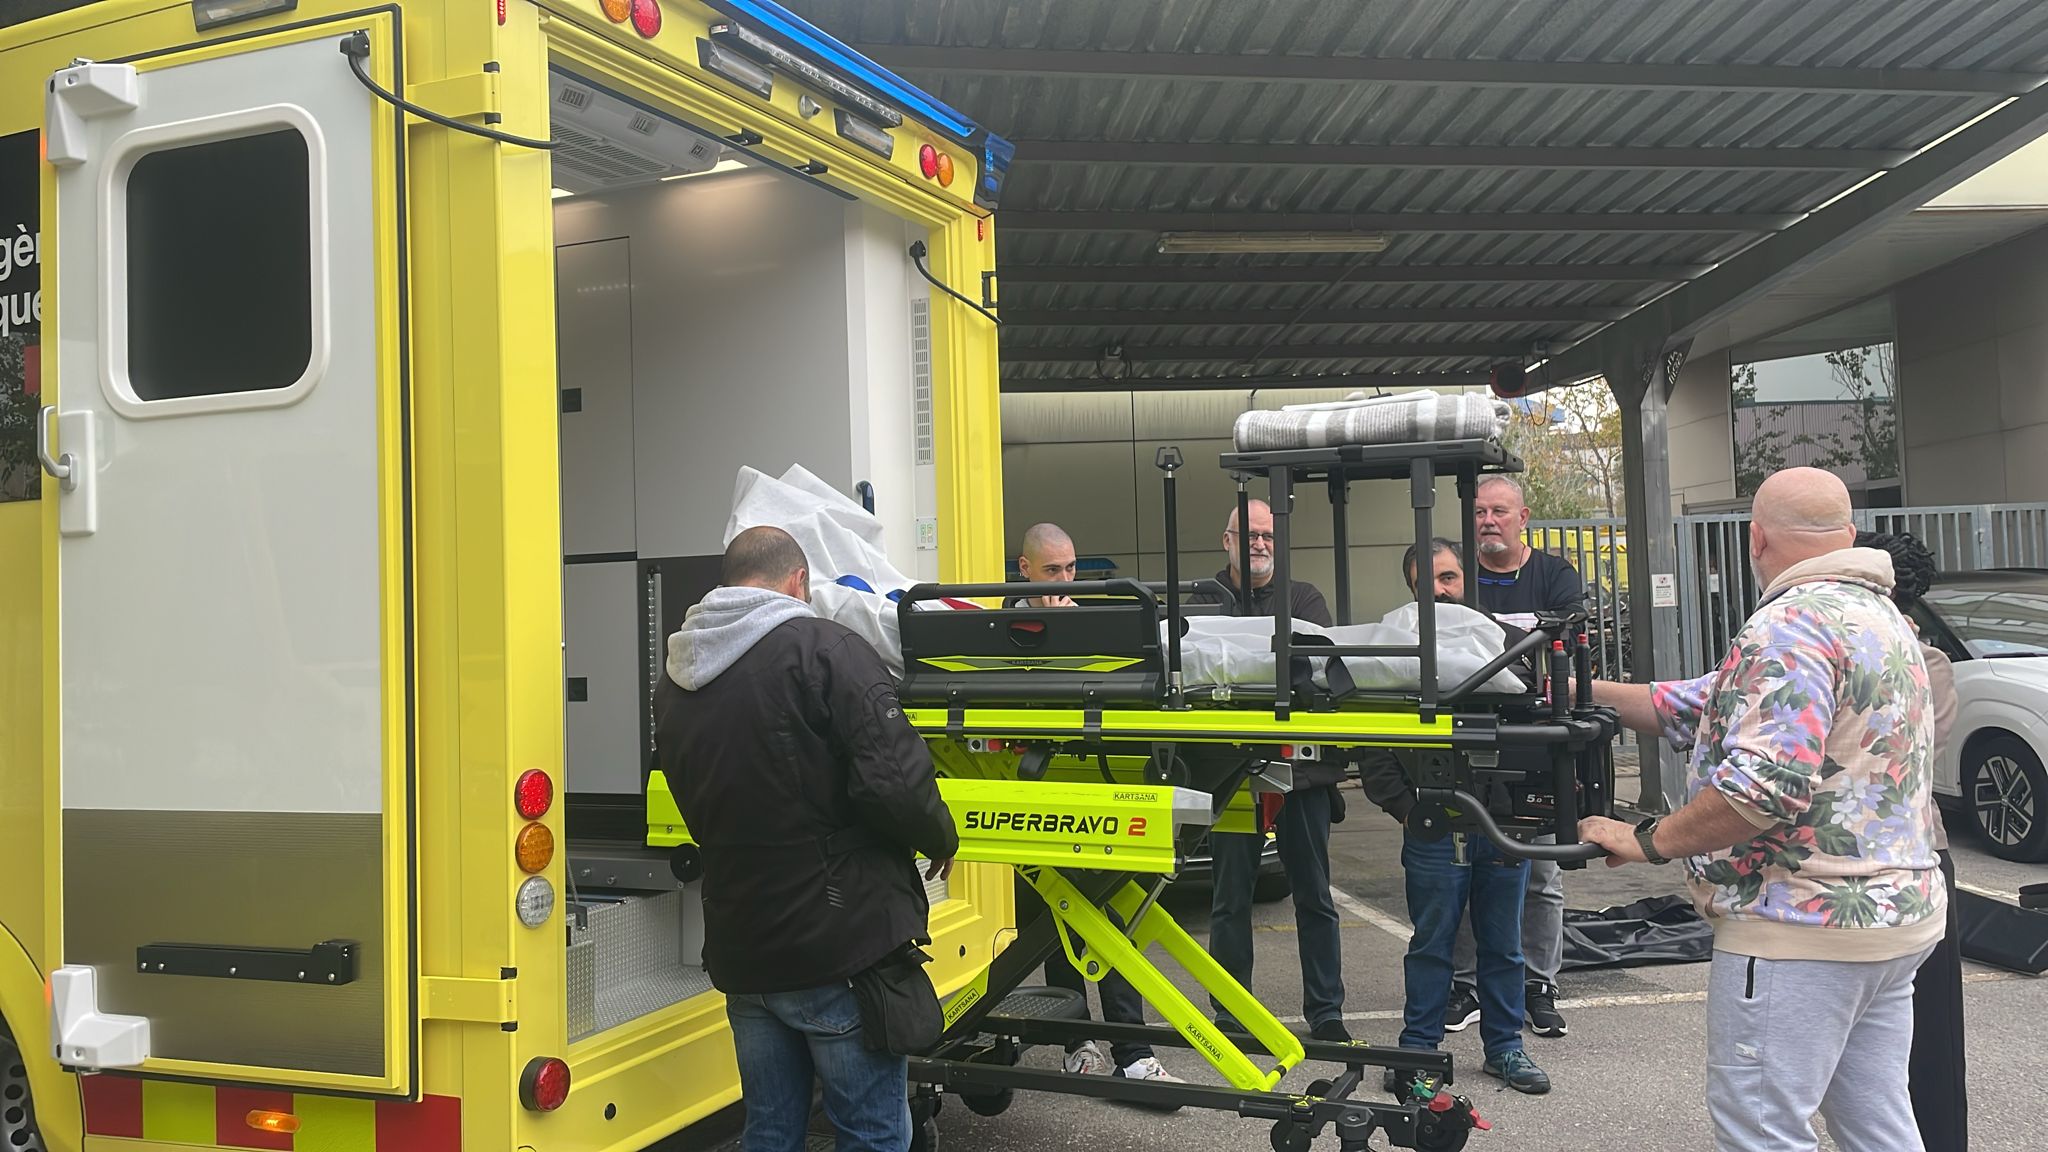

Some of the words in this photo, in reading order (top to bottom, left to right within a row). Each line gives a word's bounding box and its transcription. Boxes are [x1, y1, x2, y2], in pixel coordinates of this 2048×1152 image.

[1113, 792, 1157, 801] KARTSANA
[965, 811, 1119, 835] SUPERBRAVO
[1128, 817, 1147, 836] 2
[947, 991, 977, 1021] KARTSANA
[1187, 1023, 1222, 1060] KARTSANA
